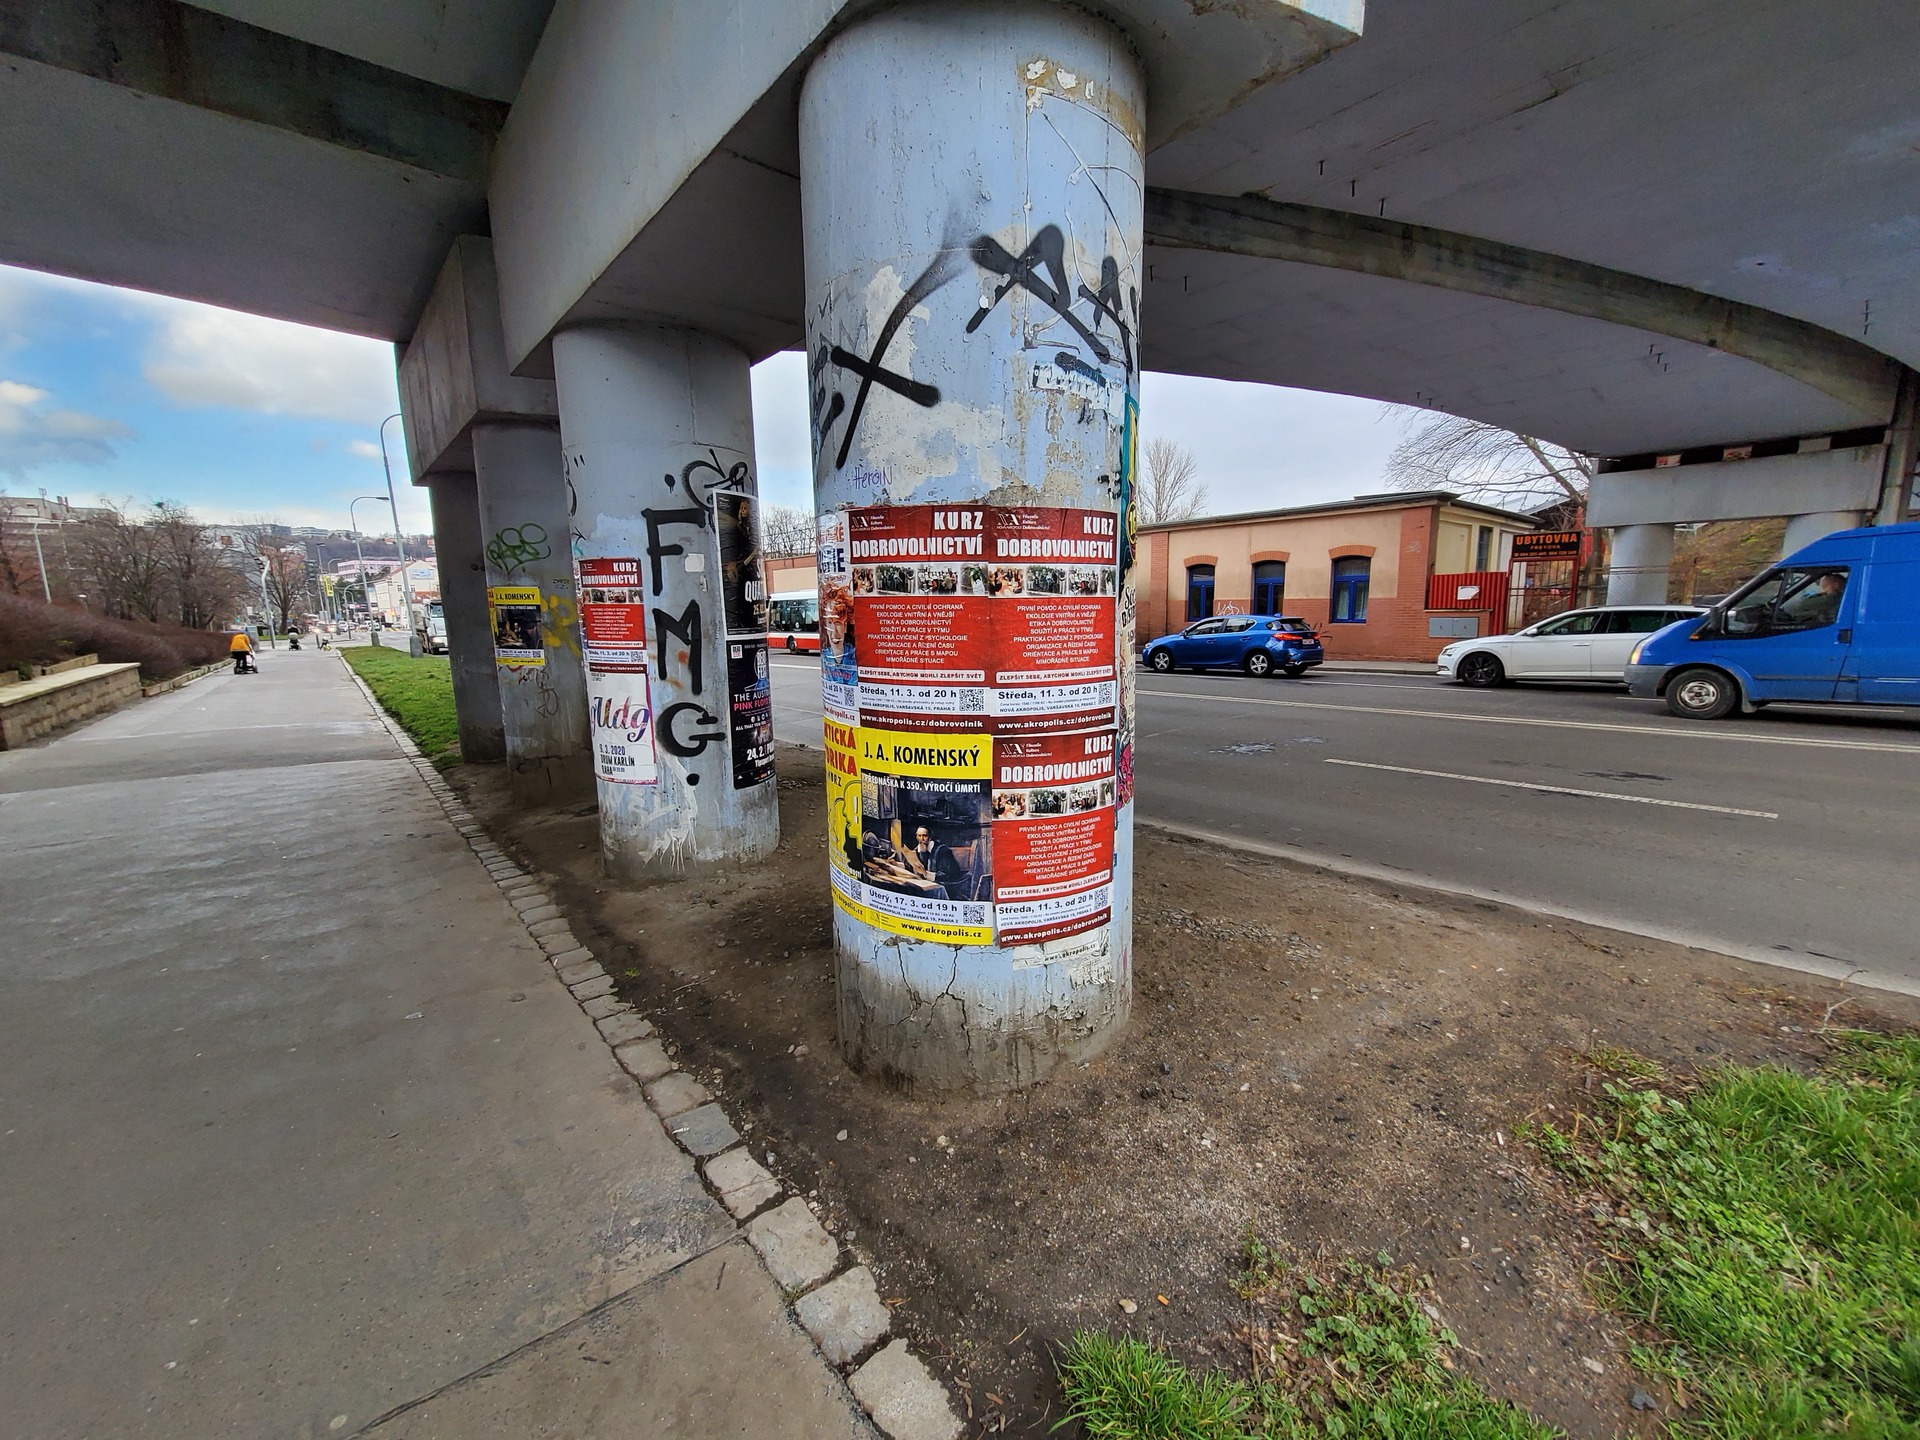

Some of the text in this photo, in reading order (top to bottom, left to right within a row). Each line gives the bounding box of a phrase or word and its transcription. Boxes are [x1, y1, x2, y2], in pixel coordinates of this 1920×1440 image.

[934, 512, 983, 529] KURZ
[1084, 516, 1113, 535] KURZ
[852, 534, 983, 557] DOBROVOLNICTVÍ
[1517, 534, 1577, 545] UBYTOVNA
[997, 539, 1113, 559] DOBROVOLNICTVÍ
[613, 562, 637, 572] KURZ
[582, 573, 637, 584] DOBROVOLNICTVÍ
[505, 592, 535, 600] KOMENSKÝ
[734, 693, 750, 702] THE
[860, 686, 887, 697] Středa,
[951, 690, 956, 698] h
[998, 691, 1036, 700] Středa,
[734, 701, 753, 711] PINK
[861, 715, 983, 727] www.akropolis.cz/dobrovolnik
[998, 712, 1111, 729] www.akropolis.cz/dobrovolnik
[611, 745, 625, 755] 2020
[1085, 735, 1112, 754] KURZ
[747, 749, 758, 760] 24.
[864, 742, 980, 766] J. A. KOMENSKÝ
[614, 756, 635, 766] KARLÍN
[1001, 753, 1112, 783] DOBROVOLNICTVÍ
[907, 781, 922, 791] 350.
[924, 781, 953, 792] VÝROČÍ
[955, 782, 980, 793] ÚMRTÍ
[869, 889, 892, 903] Úterý,
[894, 897, 907, 905] 17.
[910, 900, 918, 908] 3.
[937, 903, 948, 911] 19
[999, 906, 1034, 915] Středa,
[1038, 903, 1051, 911] 11.
[1066, 898, 1075, 907] od
[1078, 896, 1086, 904] 20
[901, 923, 981, 938] www.akropolis.cz
[1001, 913, 1107, 942] www.akropolis.cz/dobrovolnik
